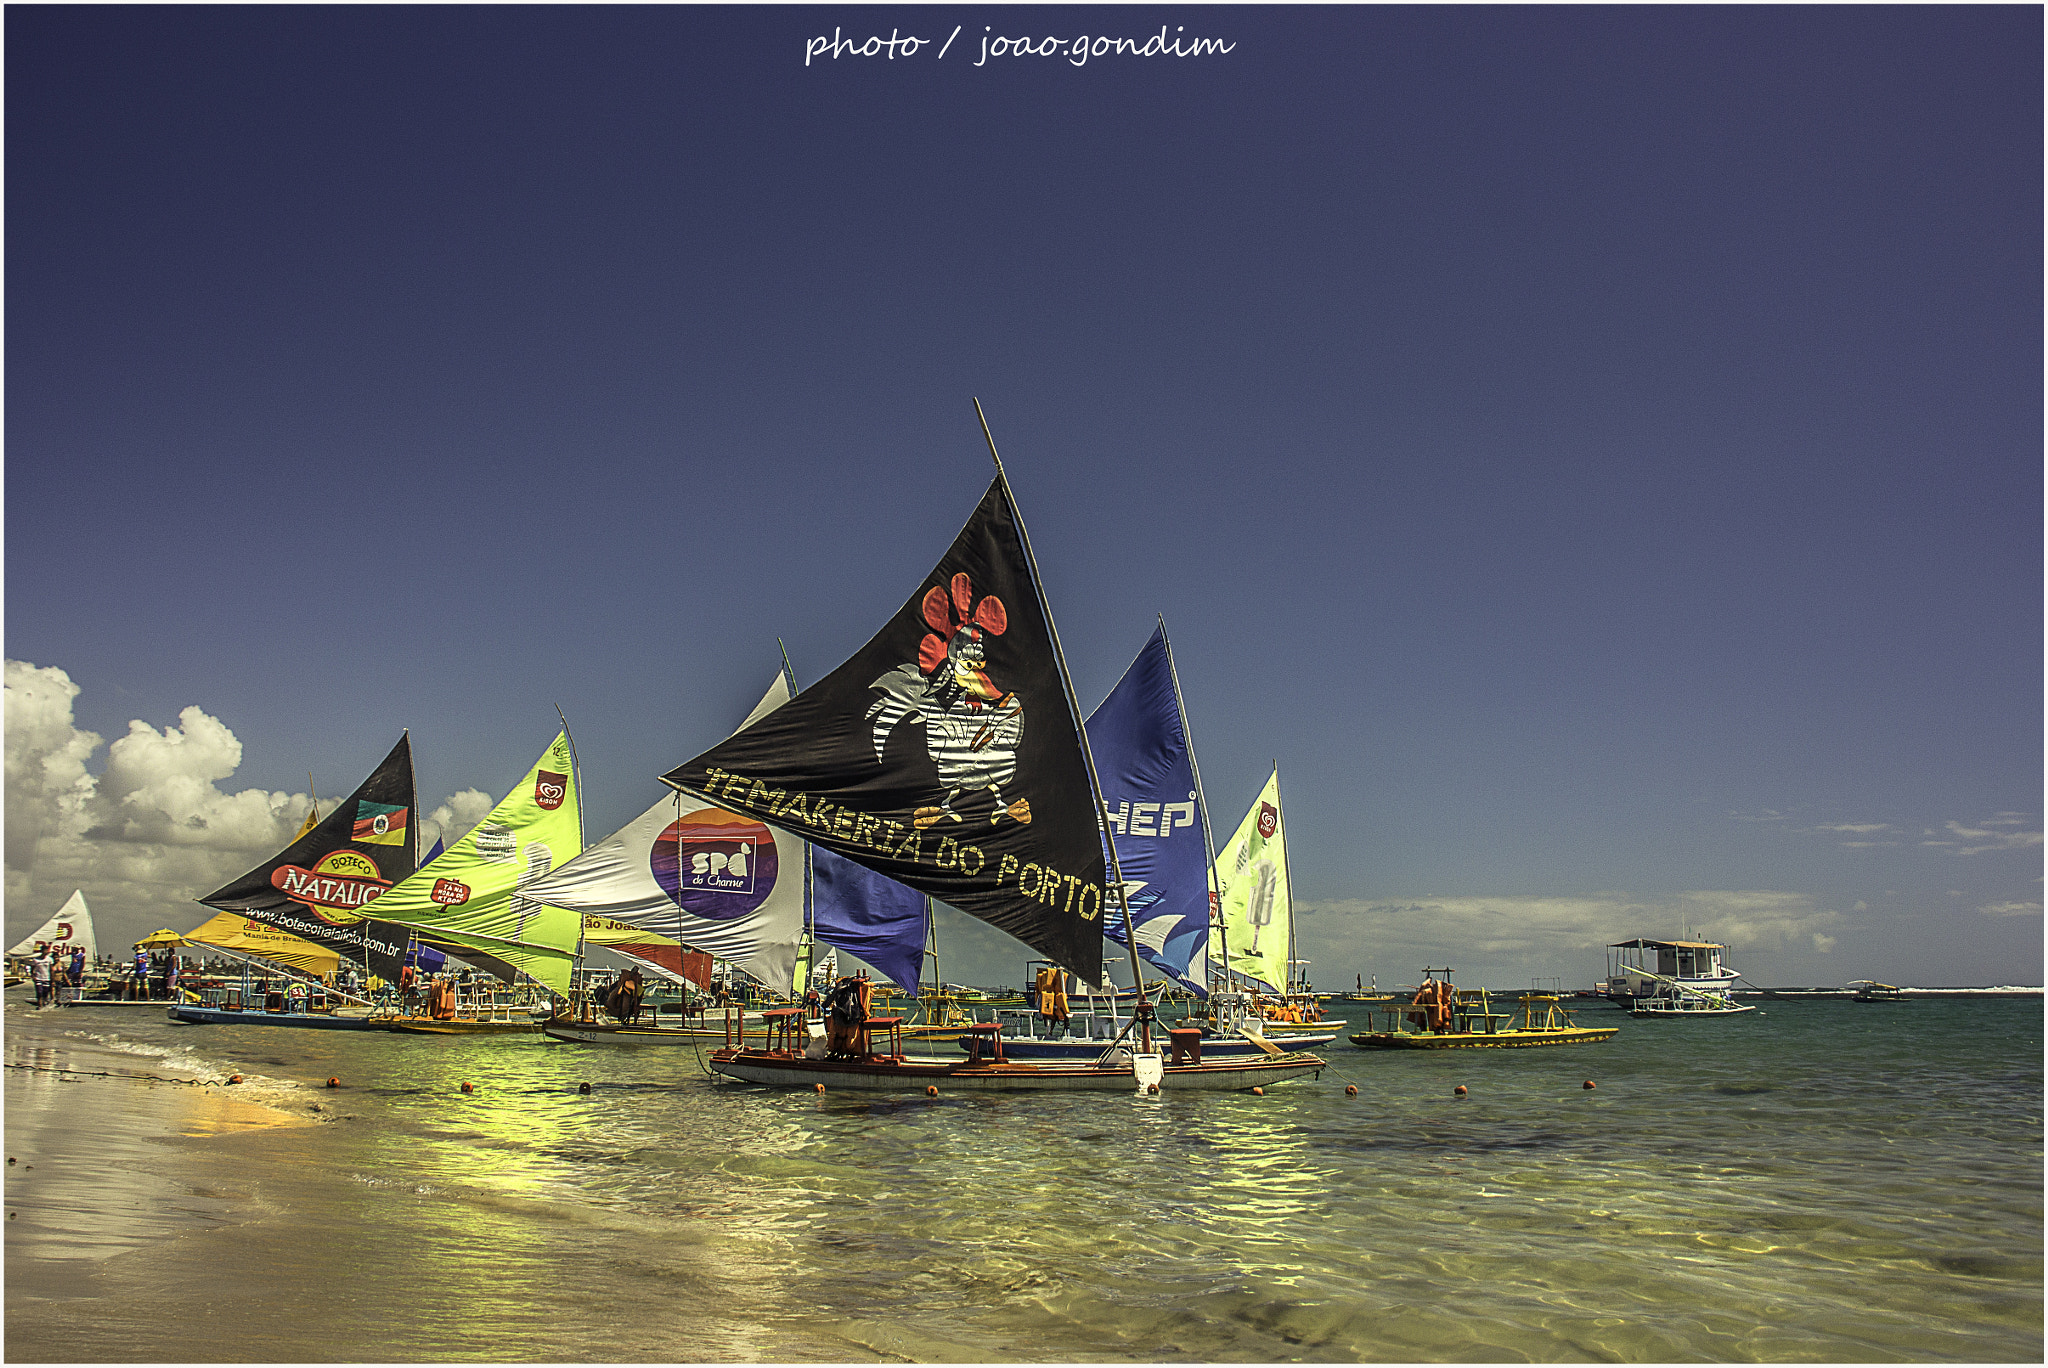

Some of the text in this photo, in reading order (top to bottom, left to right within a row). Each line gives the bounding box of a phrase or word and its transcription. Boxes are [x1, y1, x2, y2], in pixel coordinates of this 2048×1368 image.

[331, 856, 371, 875] BOTECO
[703, 768, 1101, 921] TEMAKERIA DO PORTO
